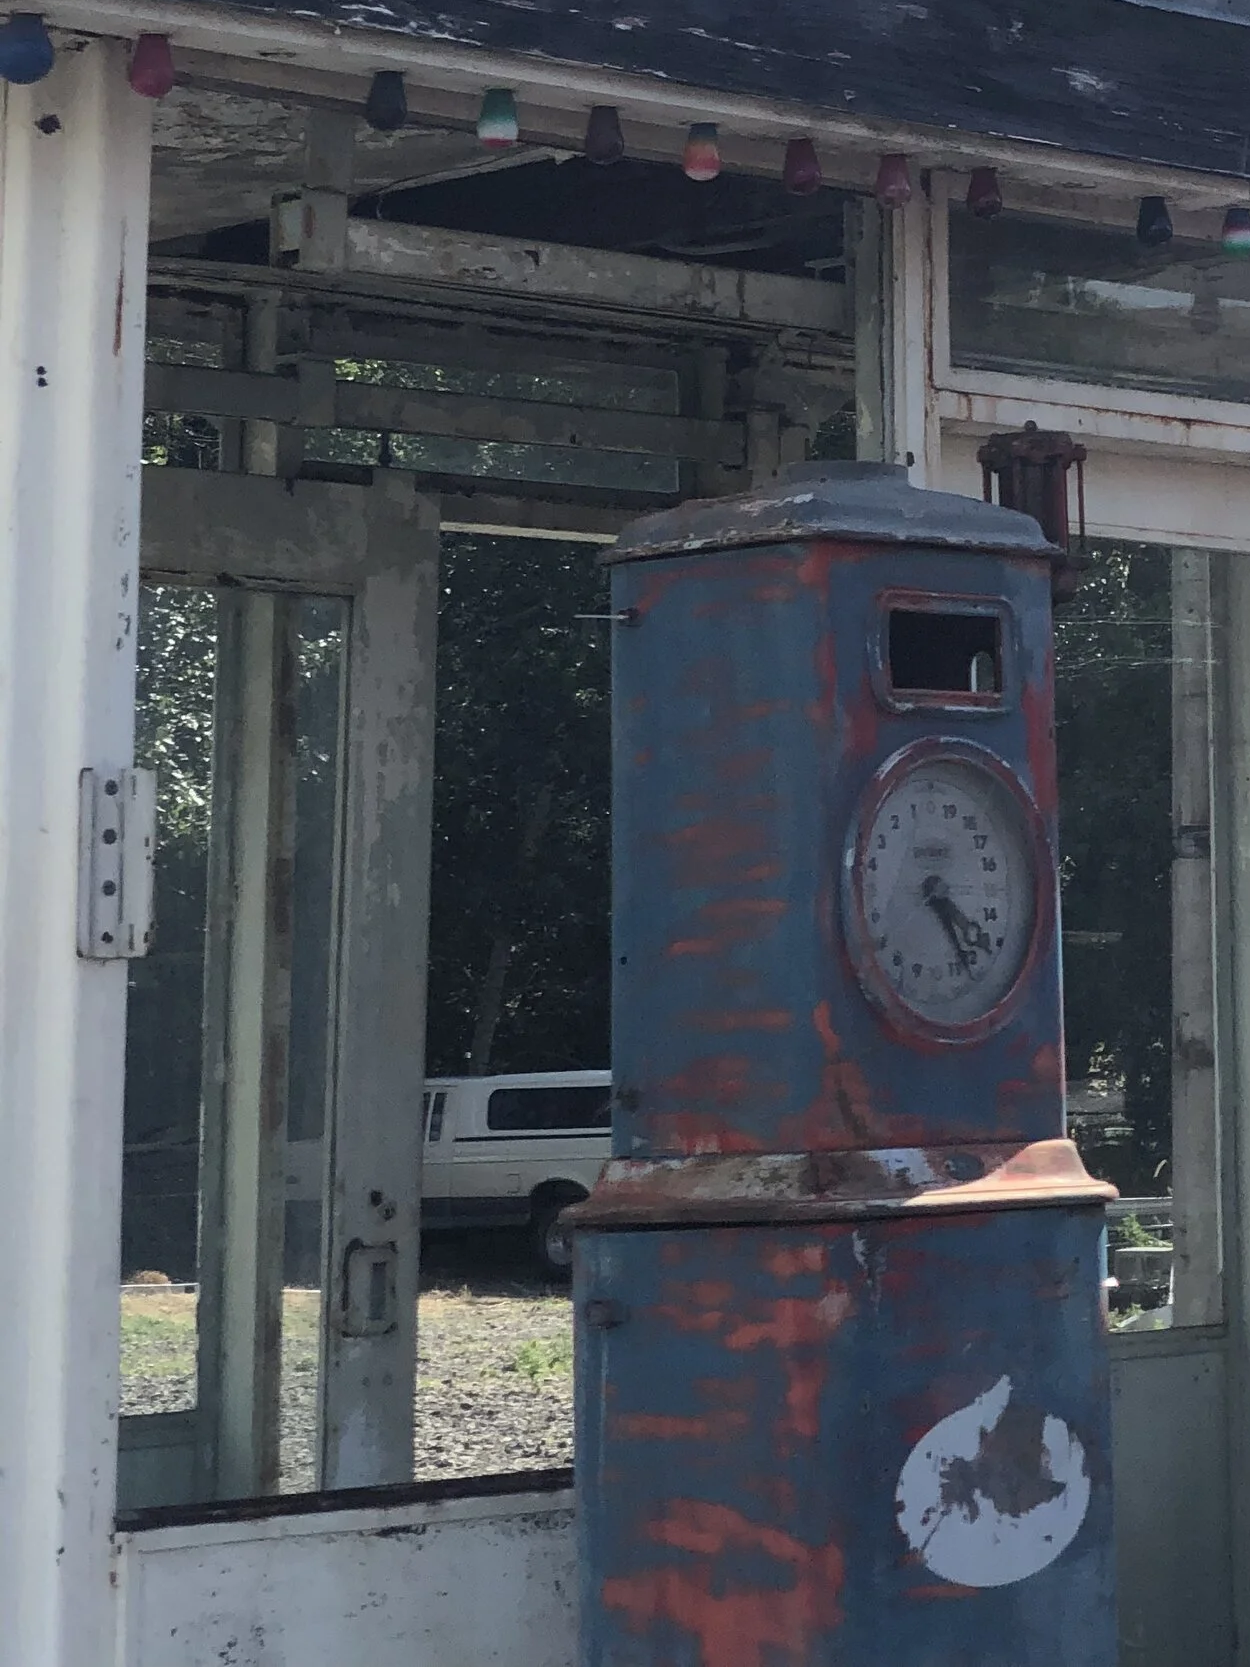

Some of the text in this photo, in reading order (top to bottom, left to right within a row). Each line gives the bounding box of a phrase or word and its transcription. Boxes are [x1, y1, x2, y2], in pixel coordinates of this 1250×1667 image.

[942, 804, 958, 820] 19
[889, 814, 900, 830] 2
[877, 833, 887, 849] 3
[973, 834, 988, 850] 17
[982, 856, 997, 873] 16
[983, 907, 998, 922] 14
